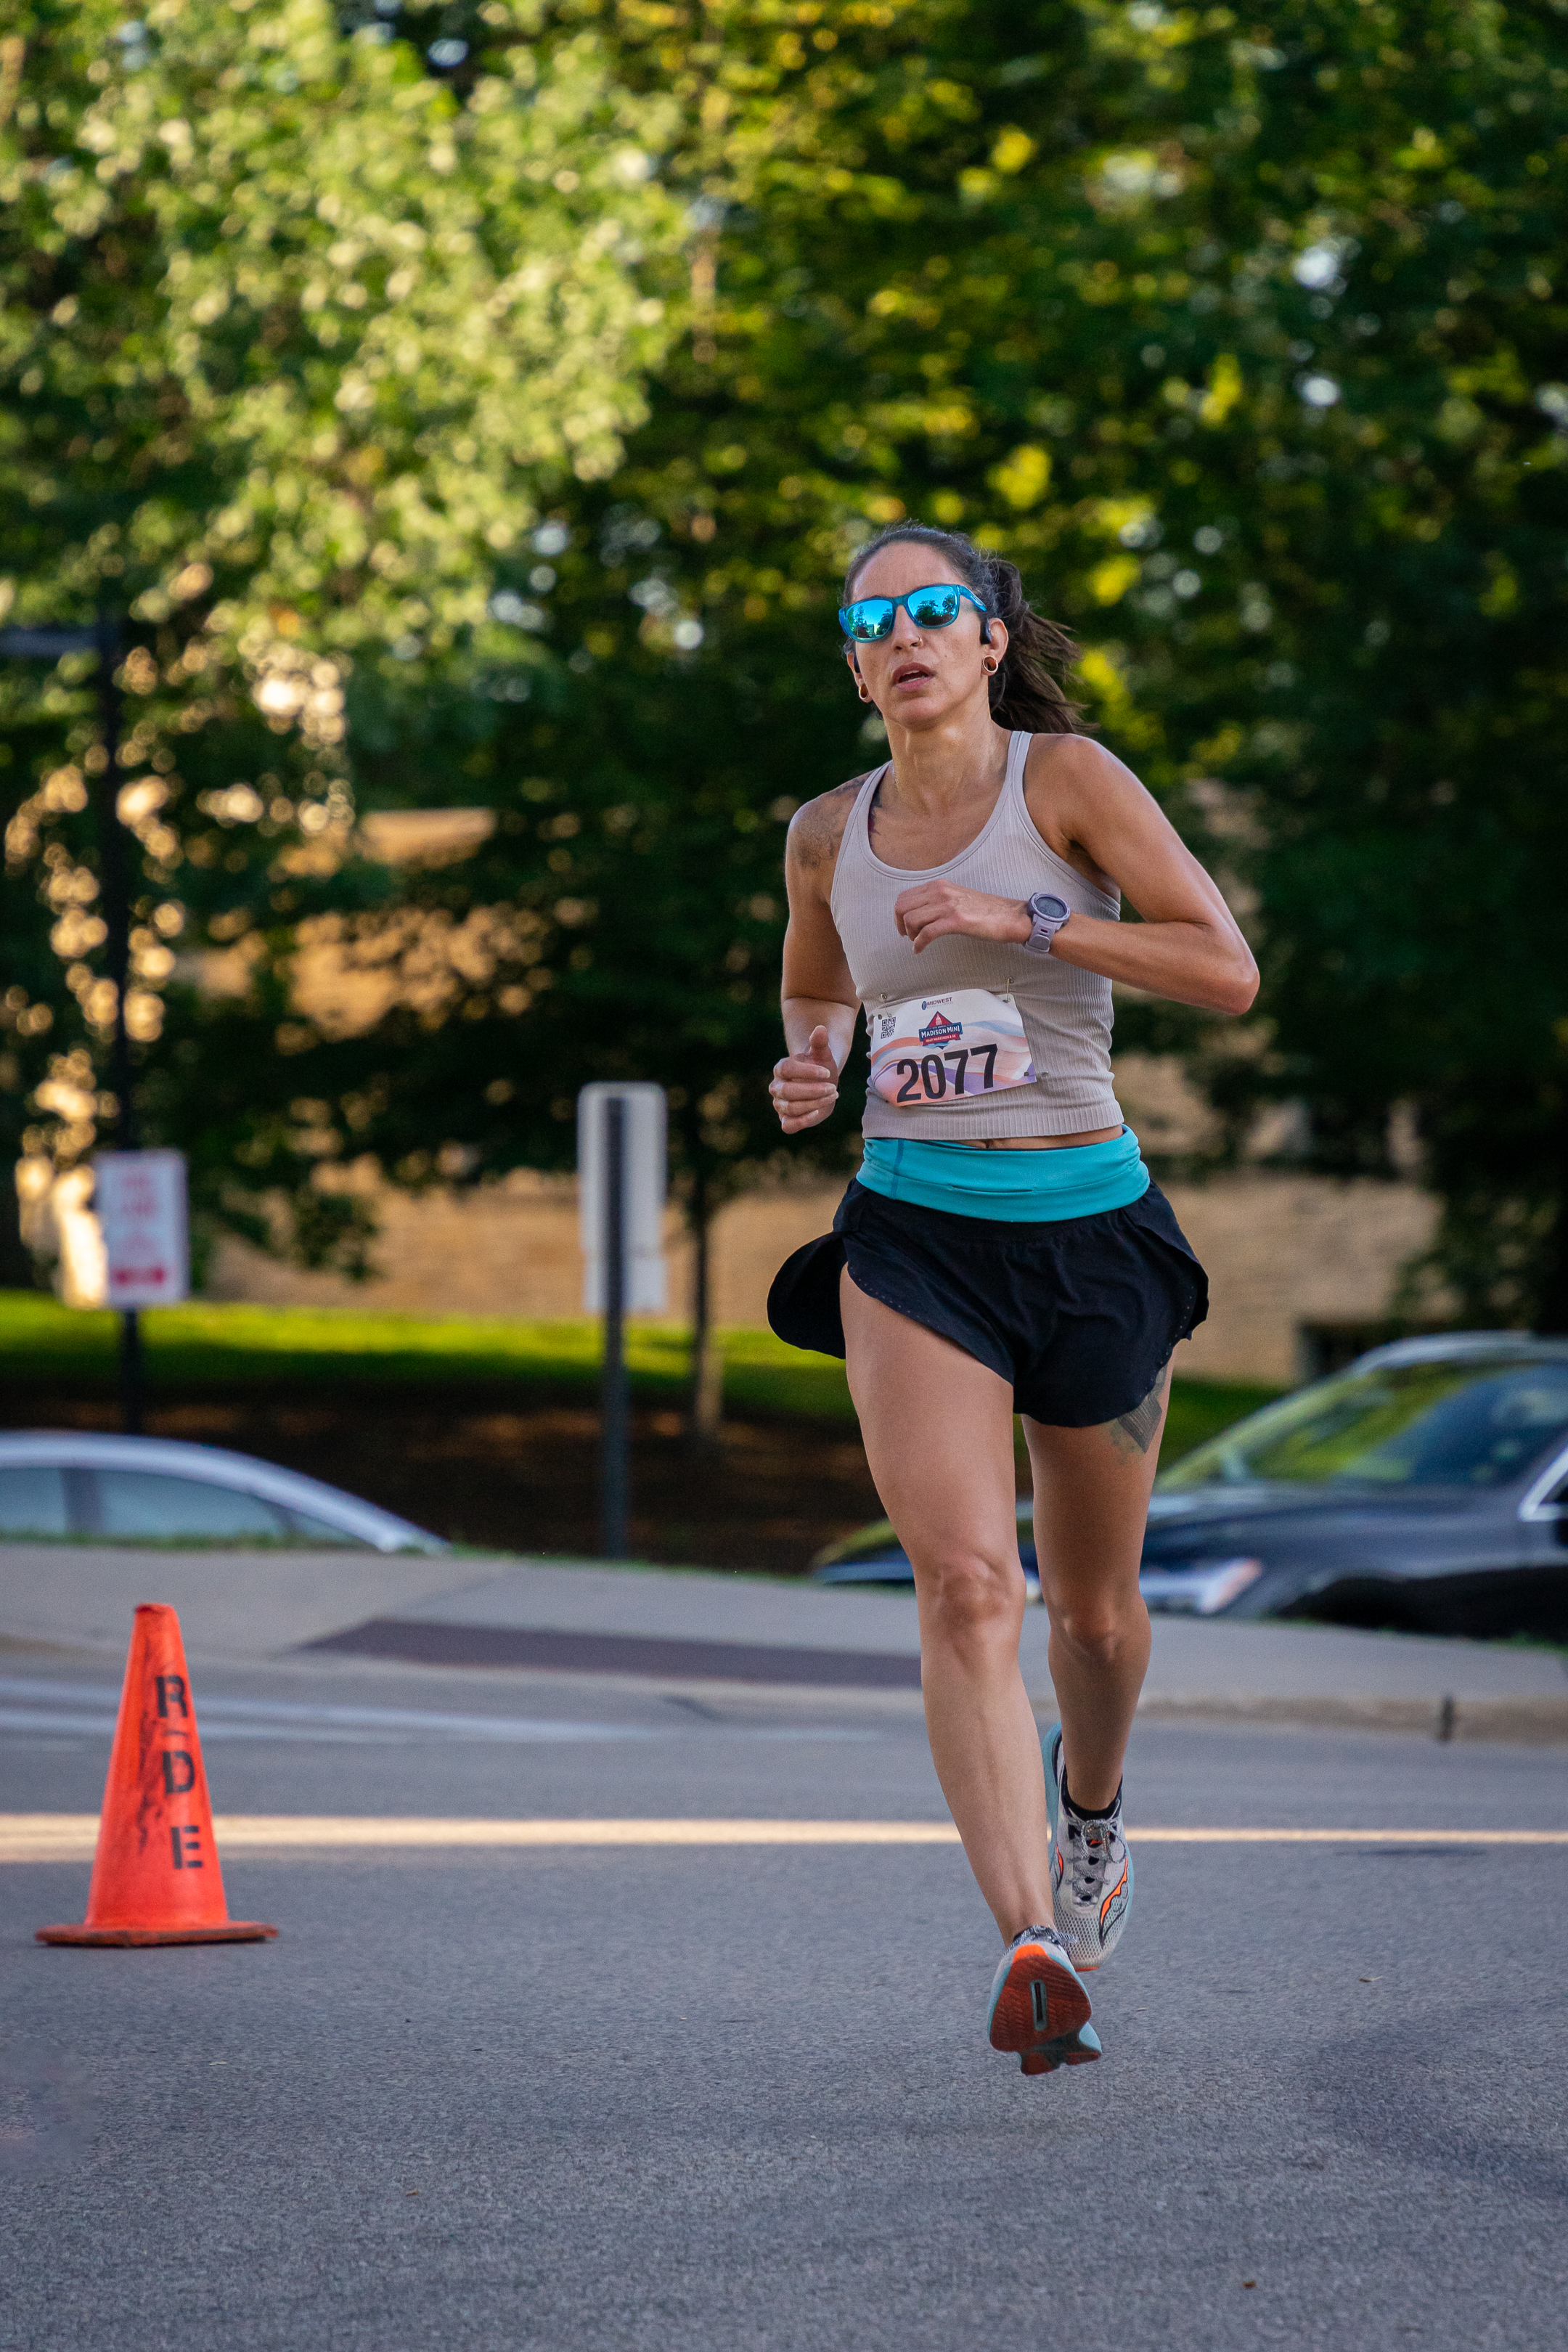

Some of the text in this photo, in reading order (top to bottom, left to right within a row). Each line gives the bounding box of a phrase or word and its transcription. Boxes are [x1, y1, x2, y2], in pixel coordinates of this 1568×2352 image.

[927, 997, 952, 1005] MIDWEST
[921, 1028, 946, 1038] MADISON
[897, 1043, 998, 1103] 2077
